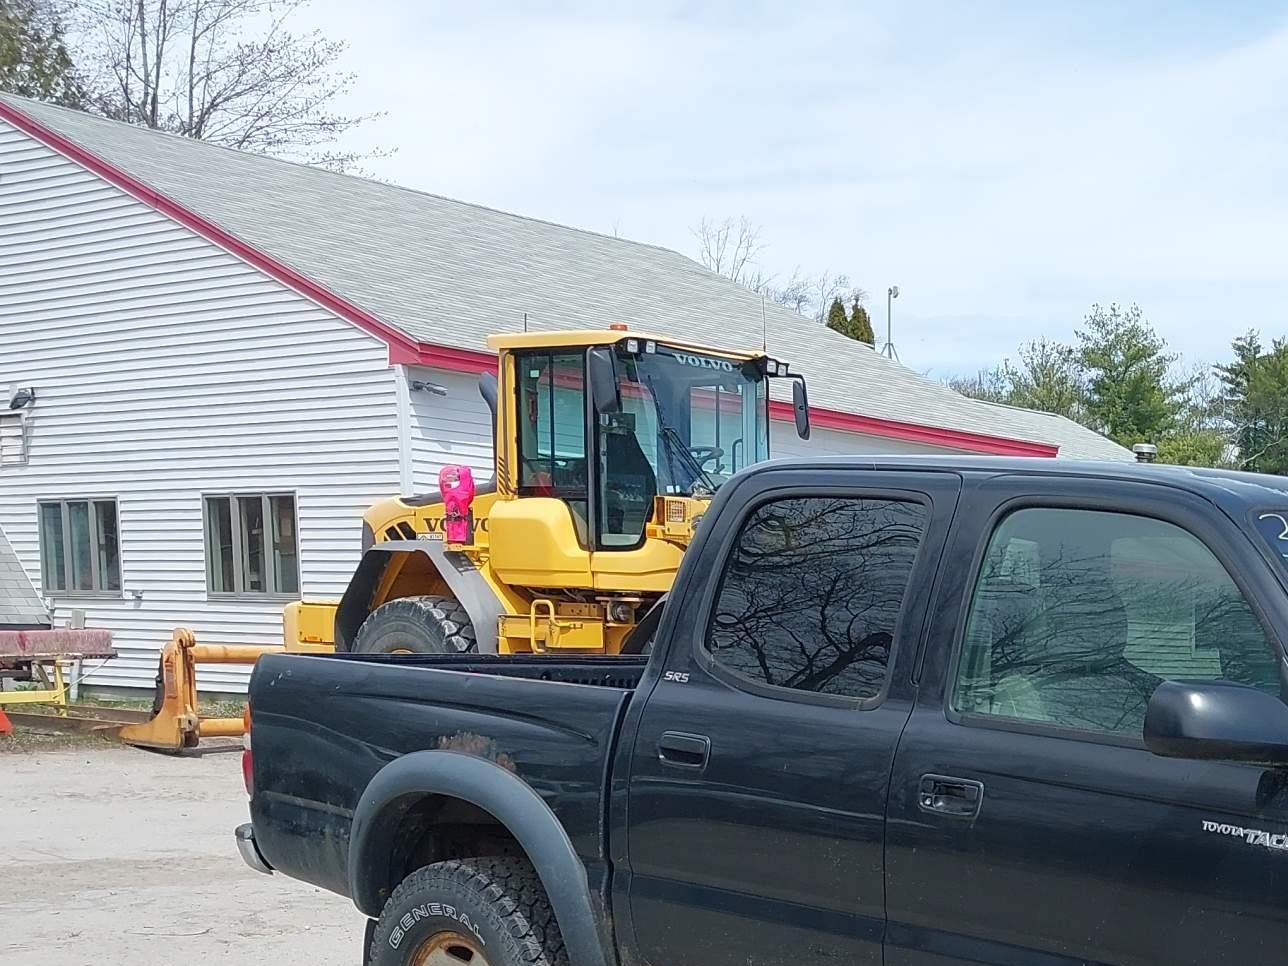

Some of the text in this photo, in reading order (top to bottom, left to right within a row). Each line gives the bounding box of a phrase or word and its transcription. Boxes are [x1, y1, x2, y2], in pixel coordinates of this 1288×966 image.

[671, 352, 733, 372] VOLVO
[1201, 820, 1244, 838] TOYOTA
[389, 902, 486, 950] GENERAL
